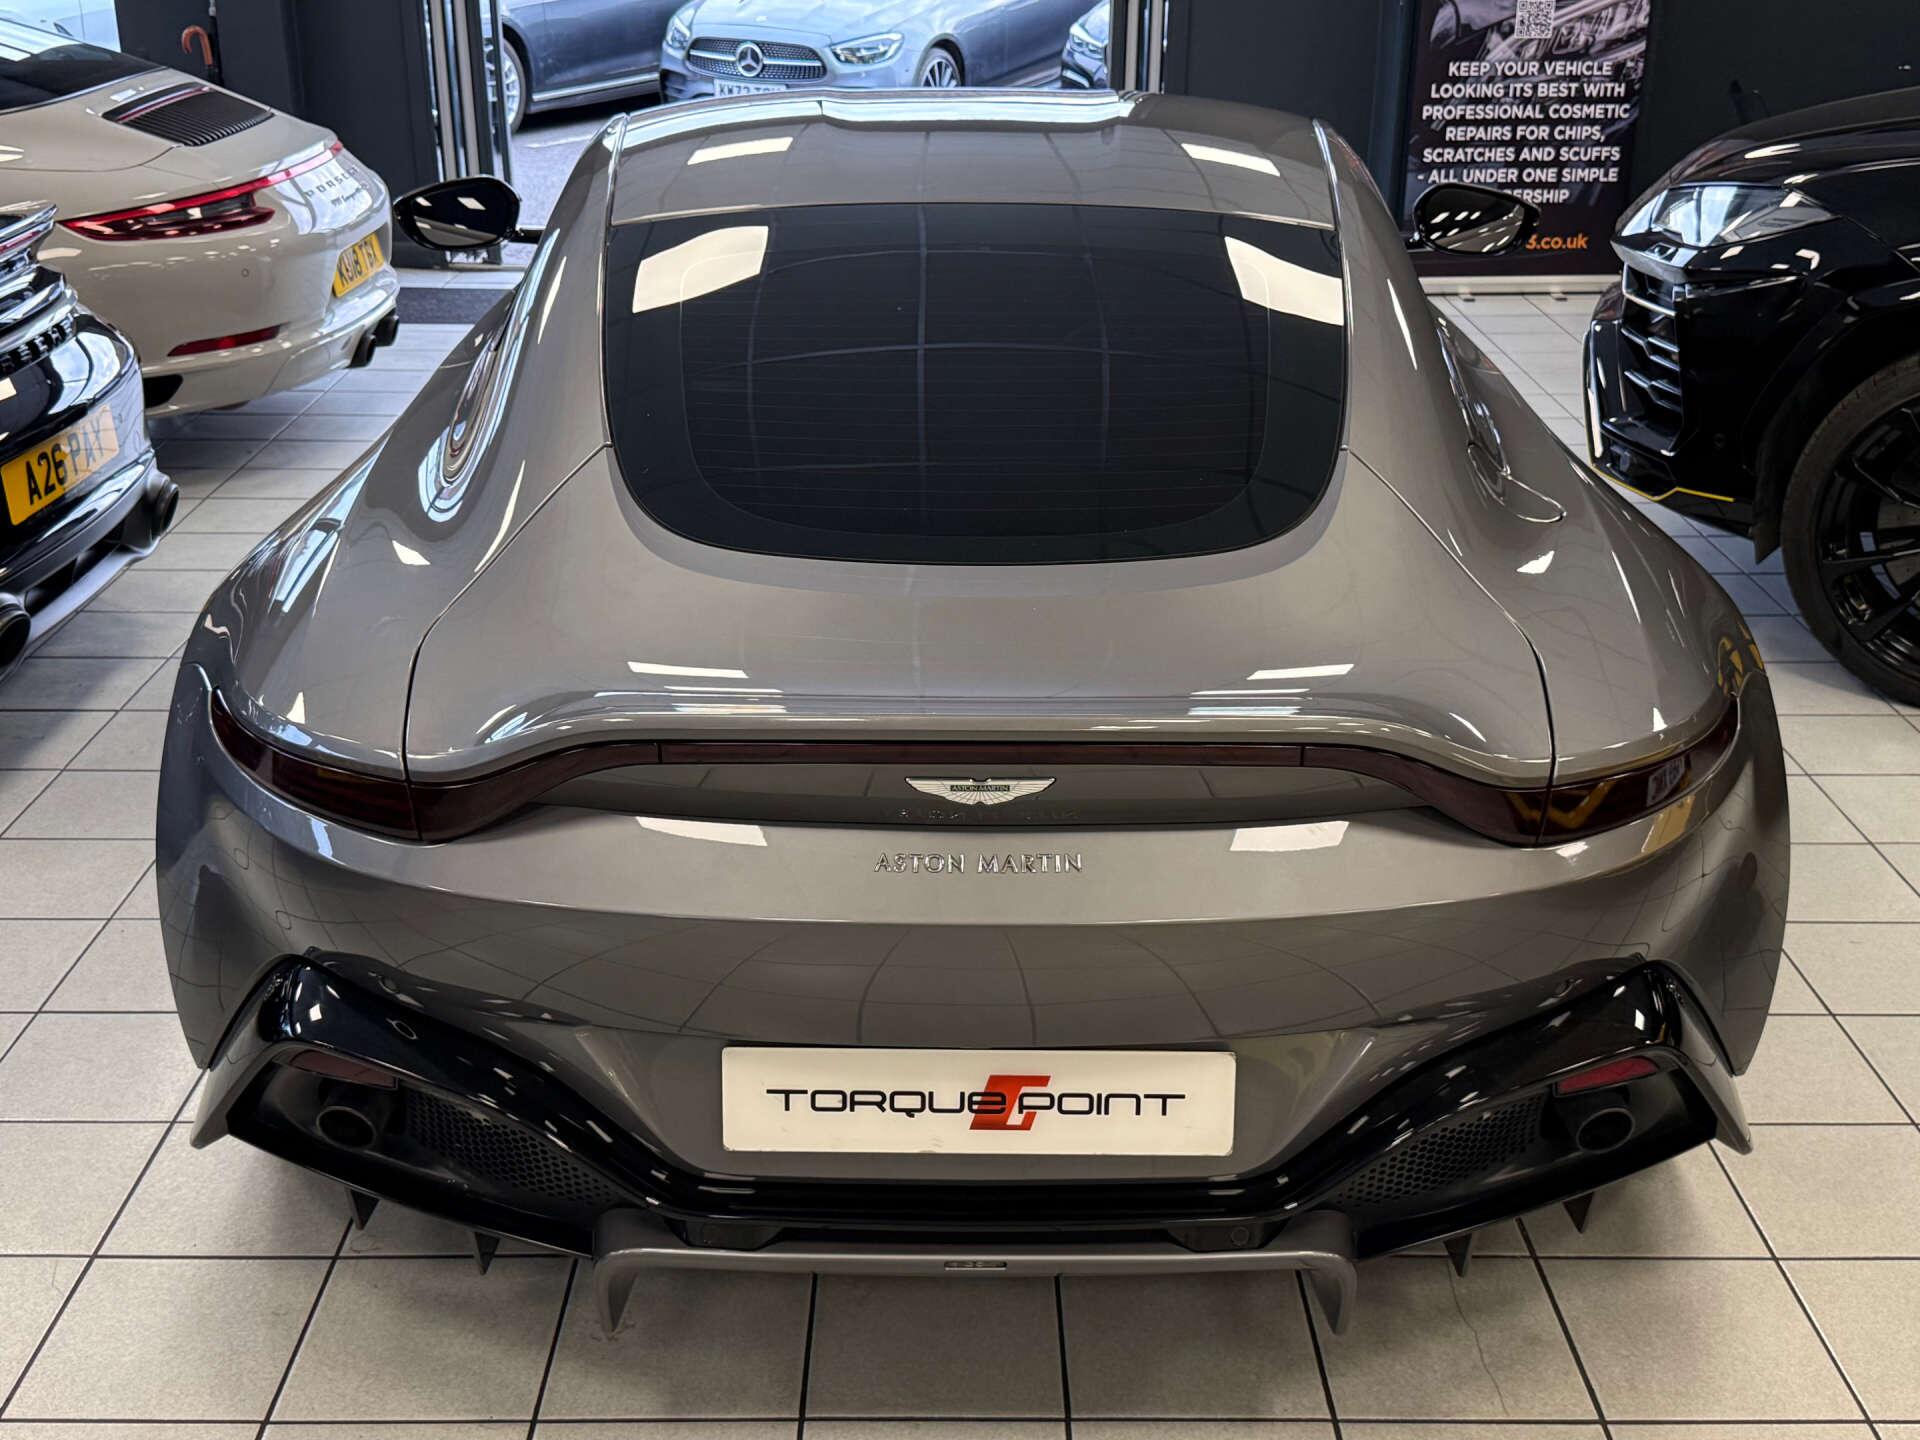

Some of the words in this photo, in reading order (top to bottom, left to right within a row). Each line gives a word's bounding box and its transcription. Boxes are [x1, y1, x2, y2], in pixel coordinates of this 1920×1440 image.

[1448, 62, 1490, 77] KEEP
[1494, 61, 1539, 76] YOUR
[1544, 61, 1613, 76] VEHICLE
[1430, 84, 1504, 98] LOOKING
[1509, 83, 1532, 98] ITS
[1537, 83, 1578, 98] BEST
[1583, 83, 1626, 98] WITH
[1422, 105, 1544, 120] PROFESSIONAL
[1548, 104, 1631, 119] COSMETIC
[1445, 126, 1511, 141] REPAIRS
[1516, 126, 1549, 141] FOR
[1553, 125, 1606, 142] CHIPS,
[1422, 148, 1515, 163] SCRATCHES
[1519, 148, 1554, 162] AND
[1559, 147, 1621, 162] SCUFFS
[1428, 169, 1458, 184] ALL
[1462, 169, 1516, 183] UNDER
[1522, 168, 1558, 183] ONE
[1561, 168, 1619, 183] SIMPLE
[1503, 188, 1570, 204] ERSHIP
[25, 443, 68, 506] A26
[67, 416, 104, 476] PAY
[951, 784, 978, 792] ASTON
[979, 784, 1010, 792] MARTIN
[874, 852, 965, 874] ASTON
[977, 853, 1084, 874] MARTIN
